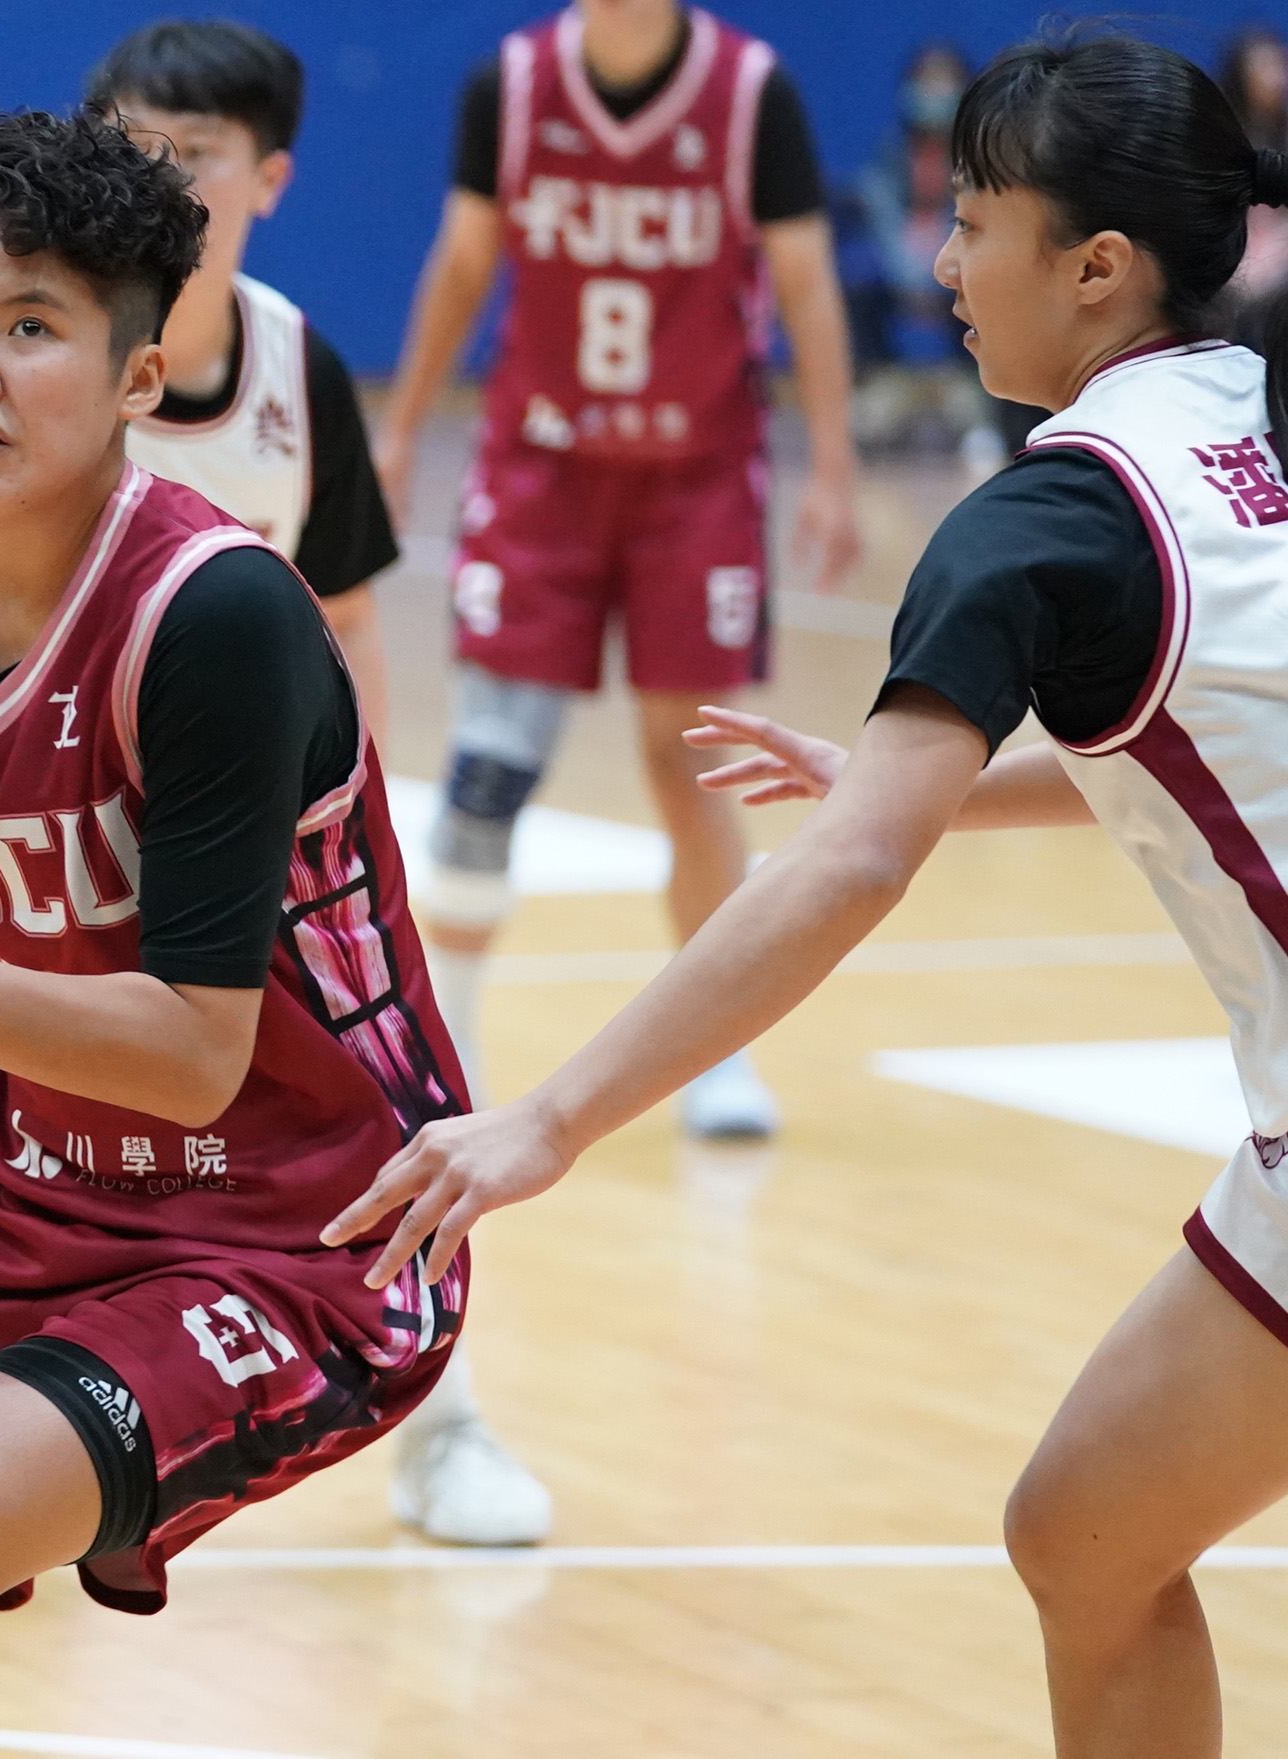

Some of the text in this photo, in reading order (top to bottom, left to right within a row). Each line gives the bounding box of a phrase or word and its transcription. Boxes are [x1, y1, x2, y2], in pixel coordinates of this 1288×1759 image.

[509, 174, 722, 270] FJCU
[577, 278, 652, 393] 8
[78, 1376, 136, 1452] adidas
